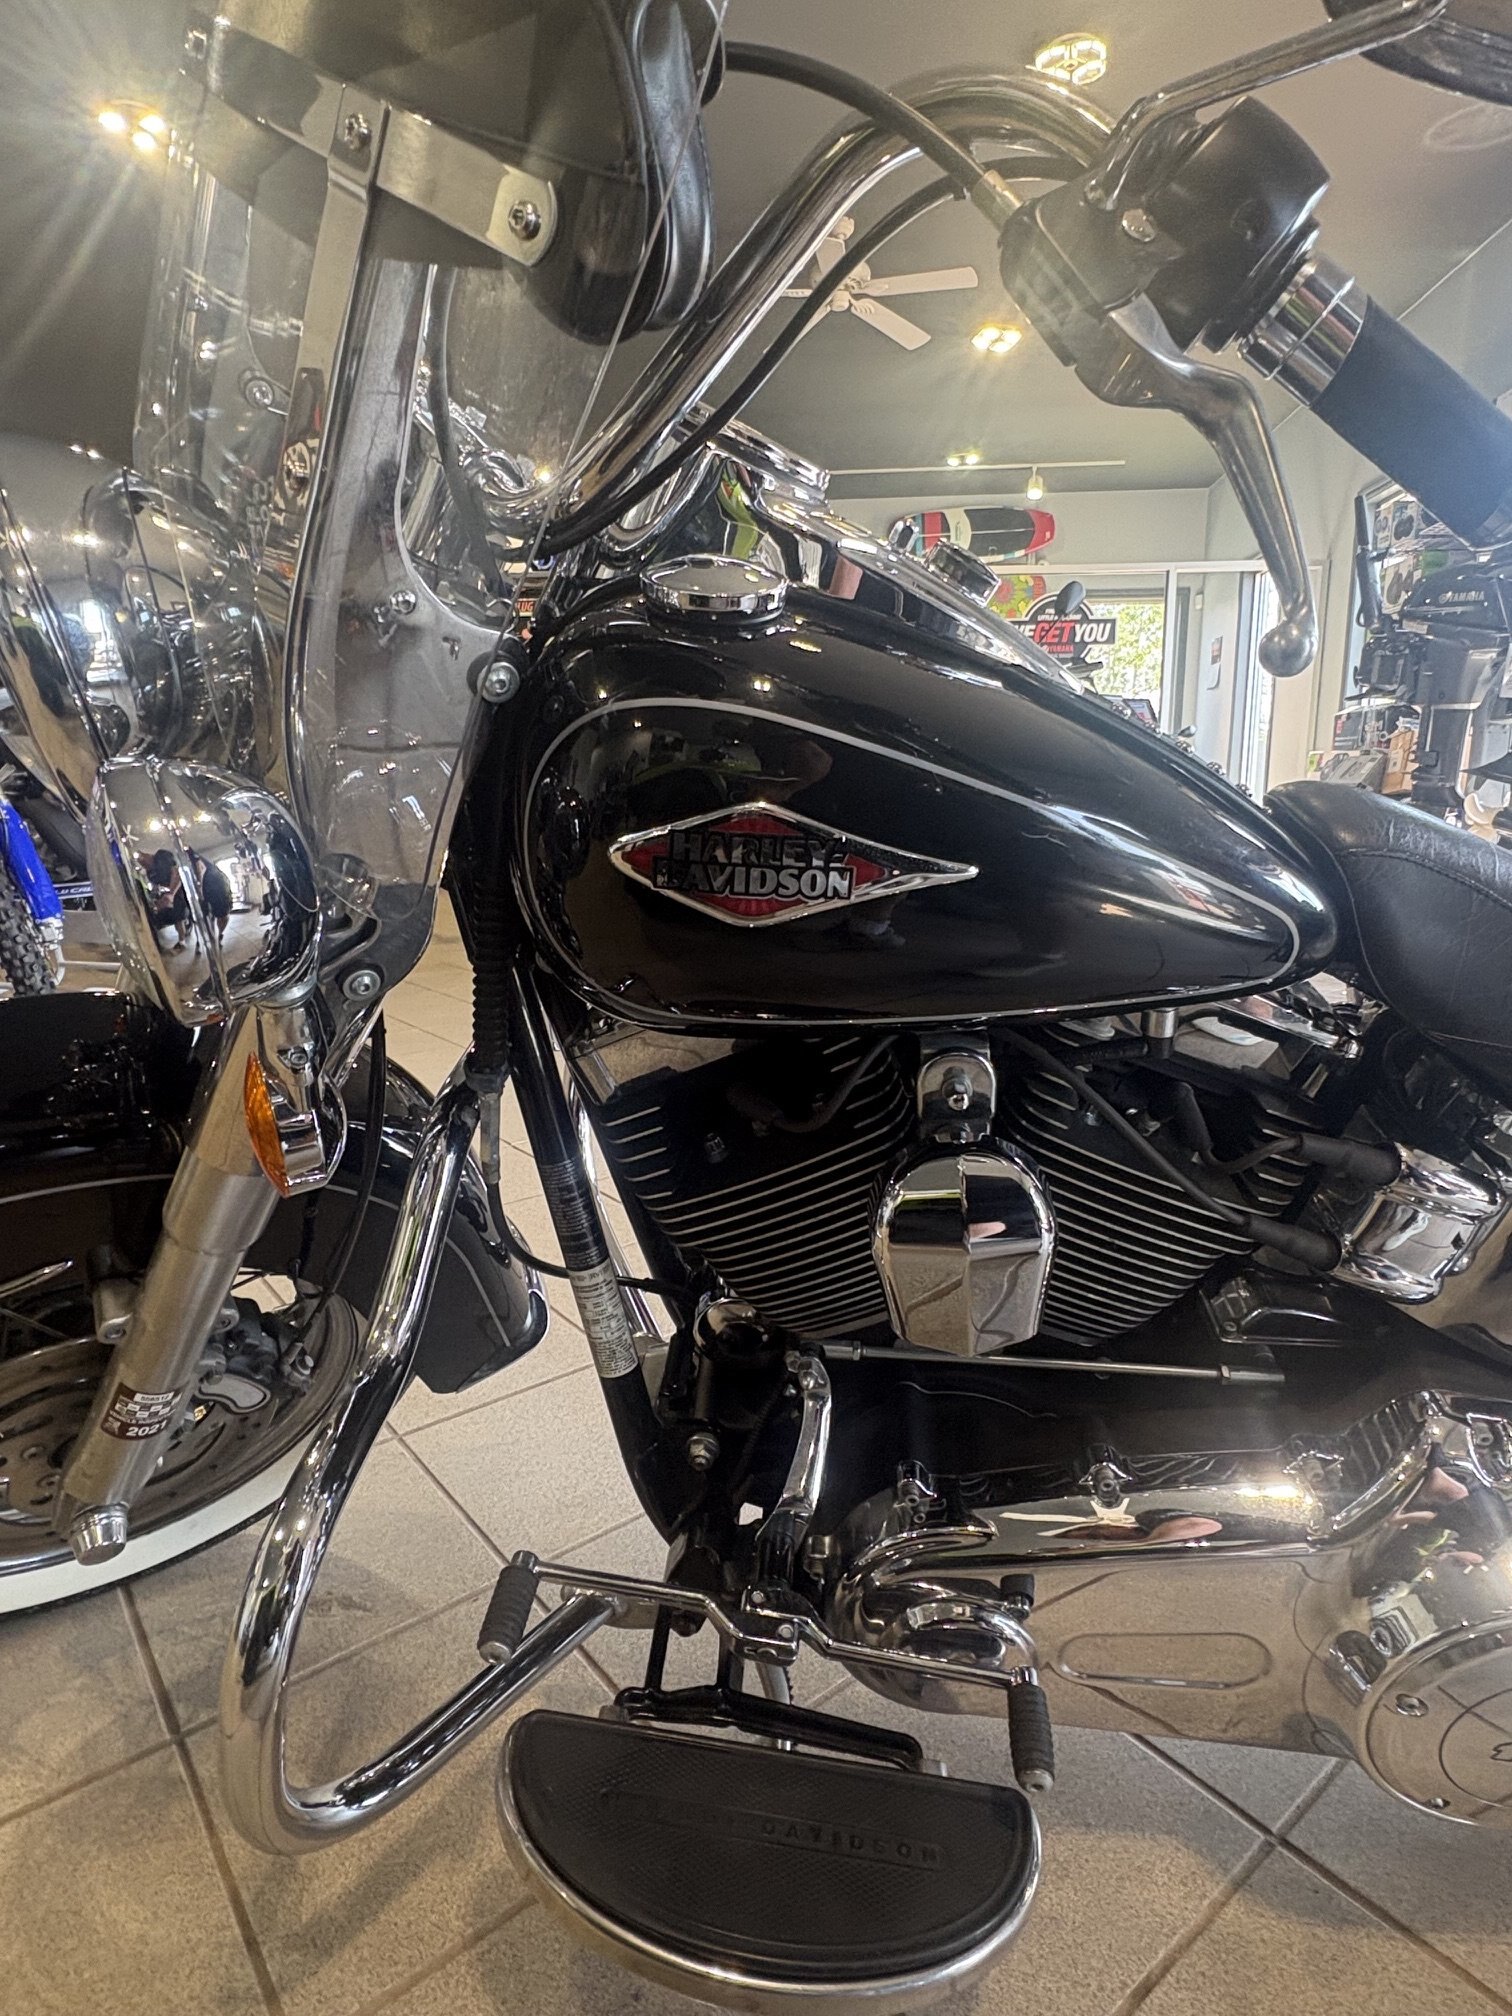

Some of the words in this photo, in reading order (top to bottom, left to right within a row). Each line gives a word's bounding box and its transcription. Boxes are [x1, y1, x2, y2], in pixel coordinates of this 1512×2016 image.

[1448, 590, 1485, 603] YAMAHA
[1033, 621, 1076, 643] GET
[1074, 622, 1112, 643] YOU
[656, 860, 851, 898] DAVIDSON
[125, 1419, 168, 1437] 2021
[761, 1818, 938, 1862] DAVIDSON
